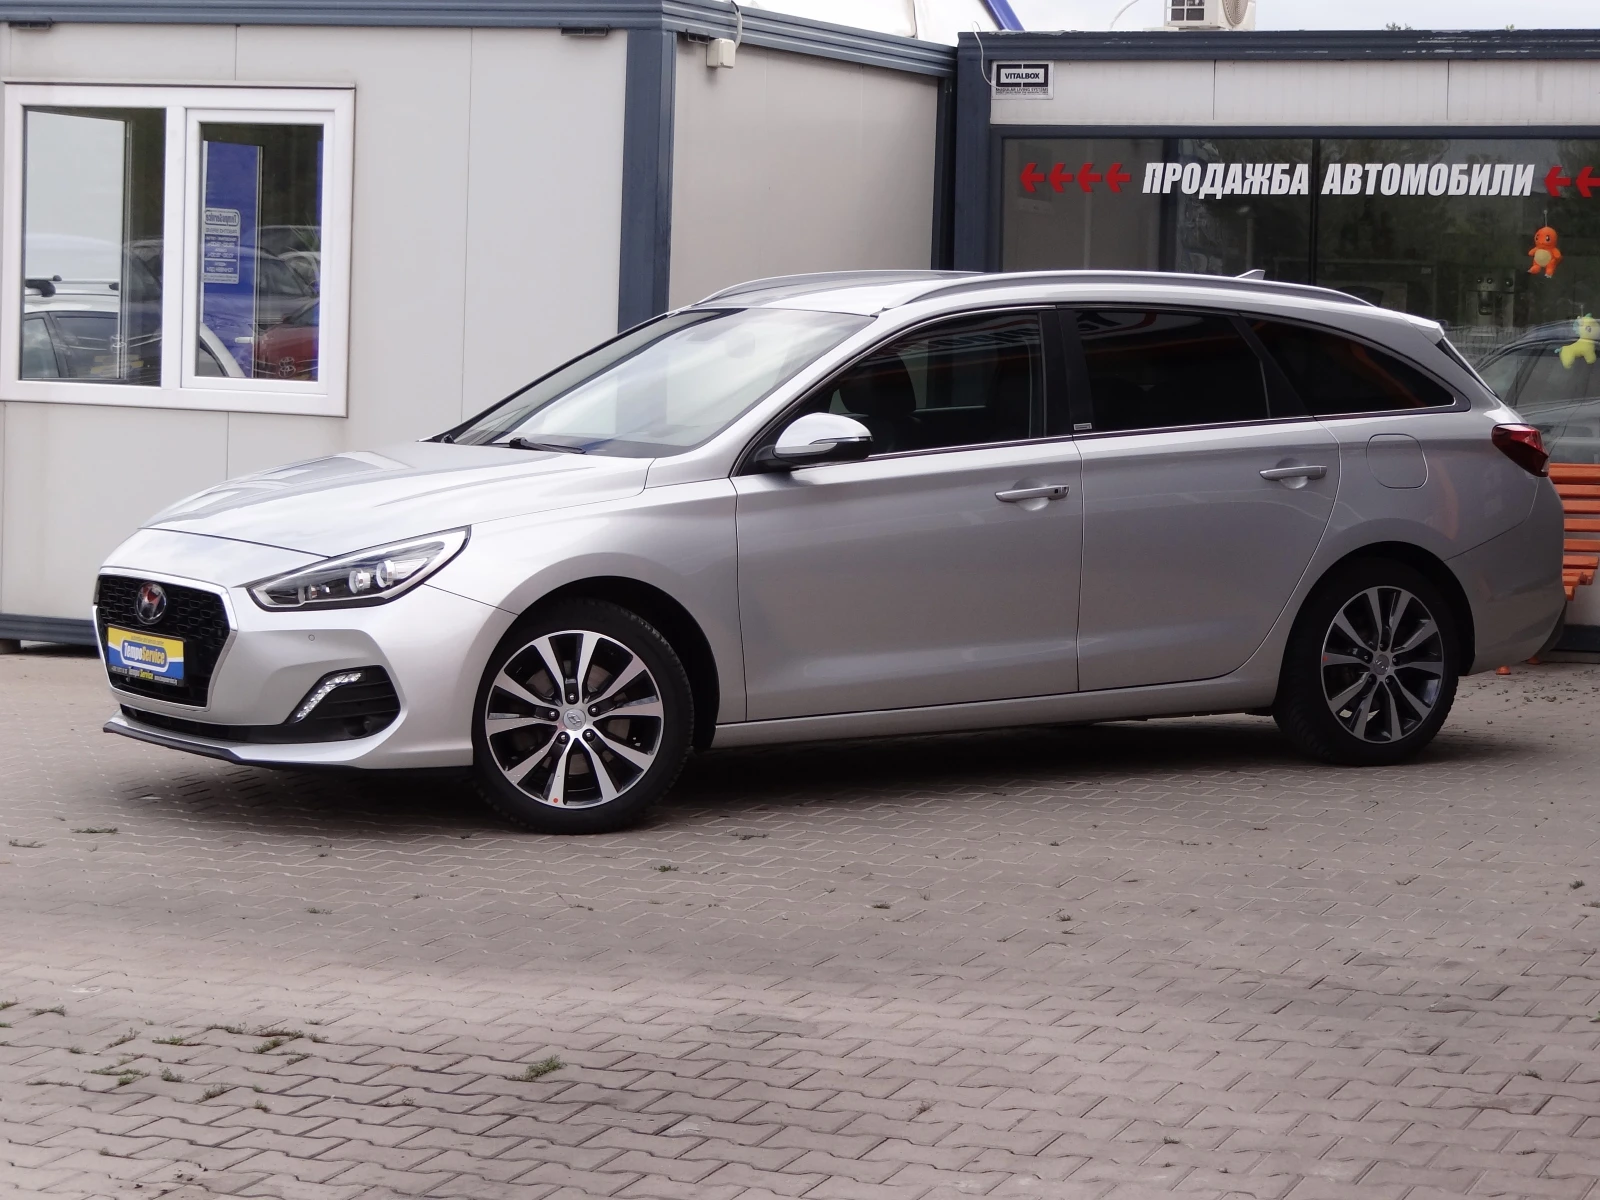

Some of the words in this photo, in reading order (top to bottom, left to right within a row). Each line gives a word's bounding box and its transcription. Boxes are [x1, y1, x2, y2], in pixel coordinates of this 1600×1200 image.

[1004, 72, 1040, 80] VITALBOX
[1142, 162, 1309, 199] ПРОДАЖБА
[1321, 163, 1535, 197] АВТОМОБИЛИ
[124, 642, 165, 665] TempoService
